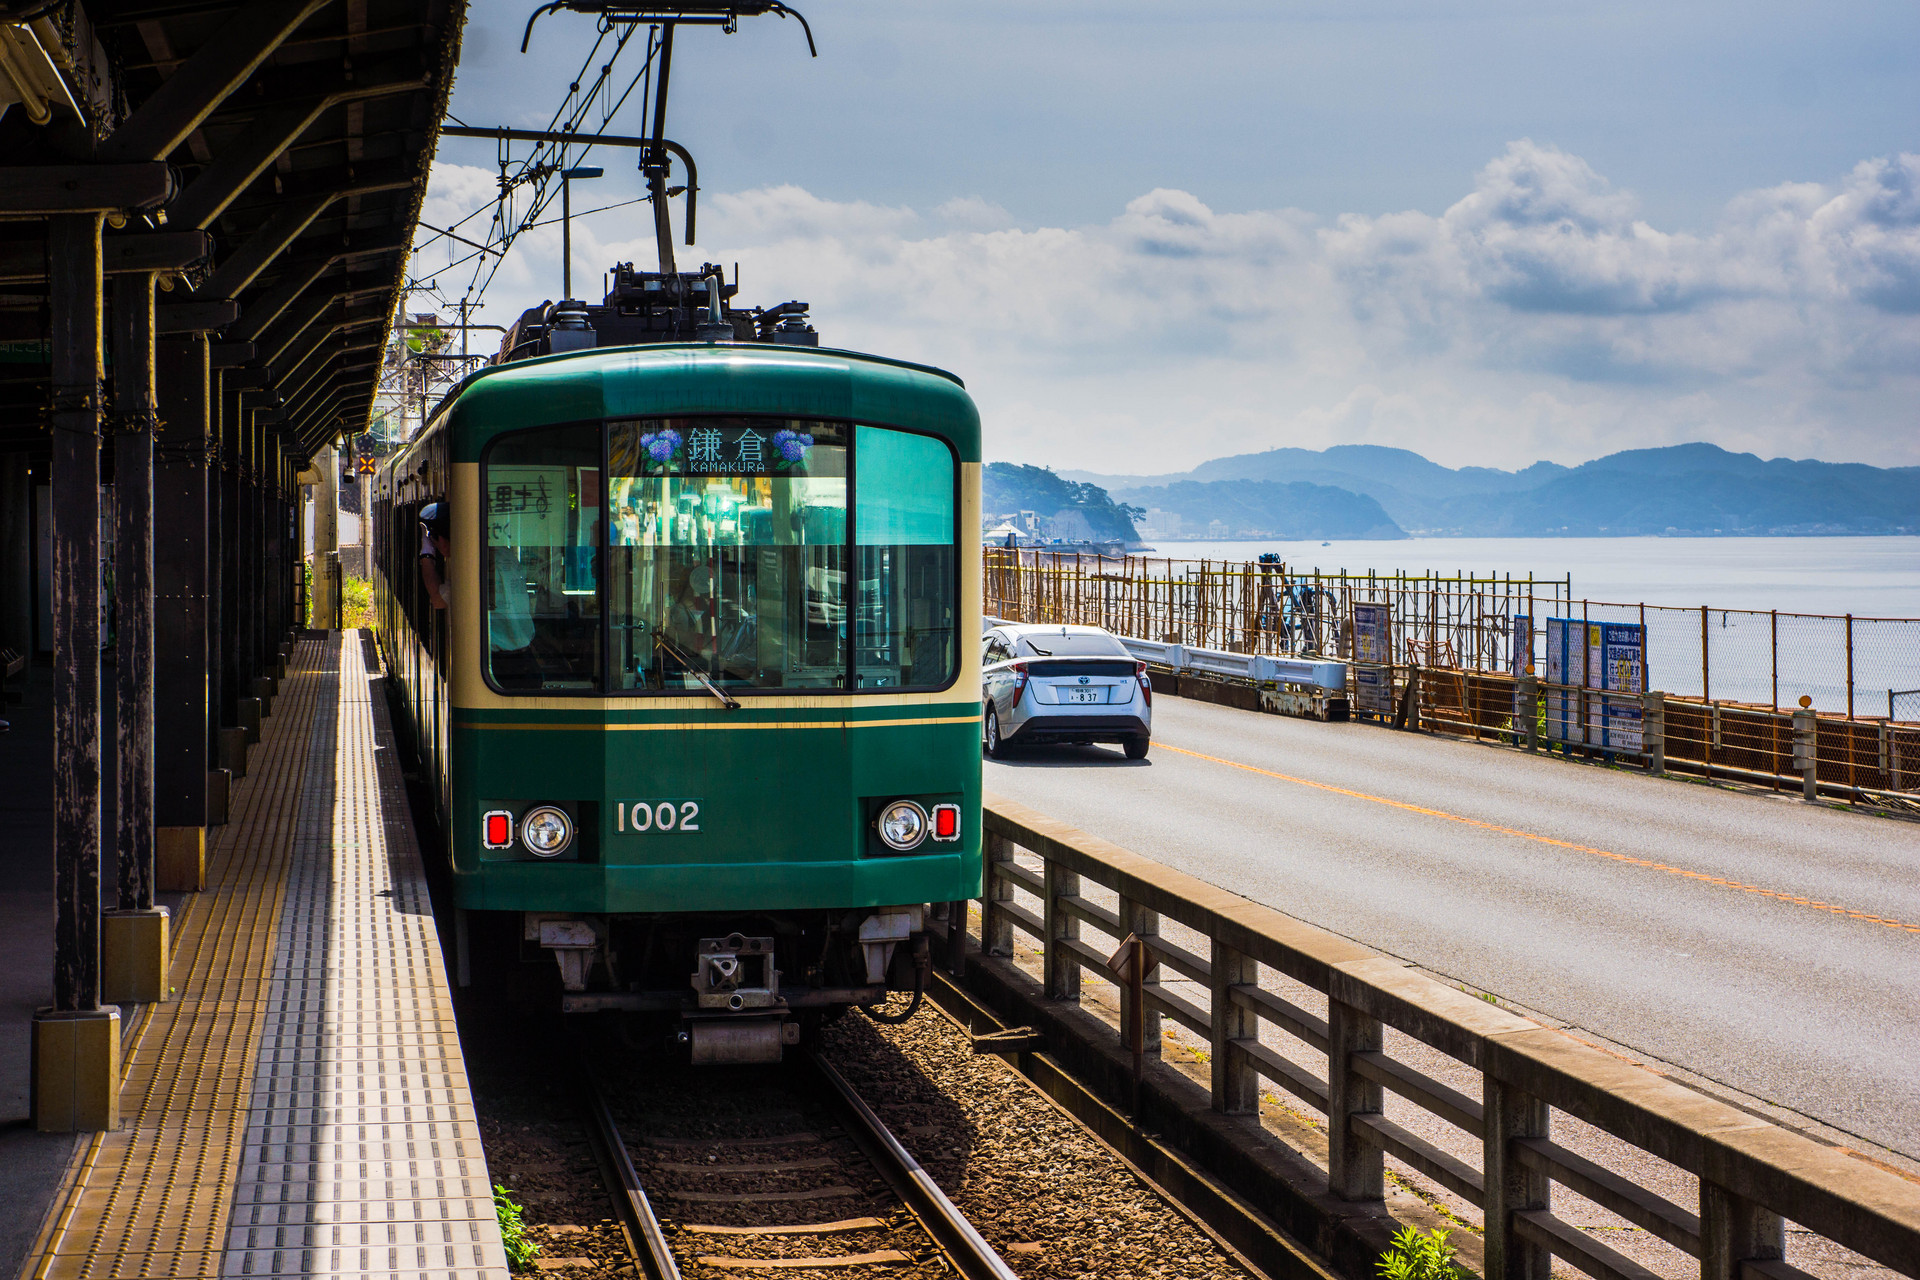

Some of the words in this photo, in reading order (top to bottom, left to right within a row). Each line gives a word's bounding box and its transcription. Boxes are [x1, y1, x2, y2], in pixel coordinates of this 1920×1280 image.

[687, 427, 768, 462] 鎌倉
[690, 462, 765, 473] KAMAKURA
[618, 801, 700, 832] 1002
